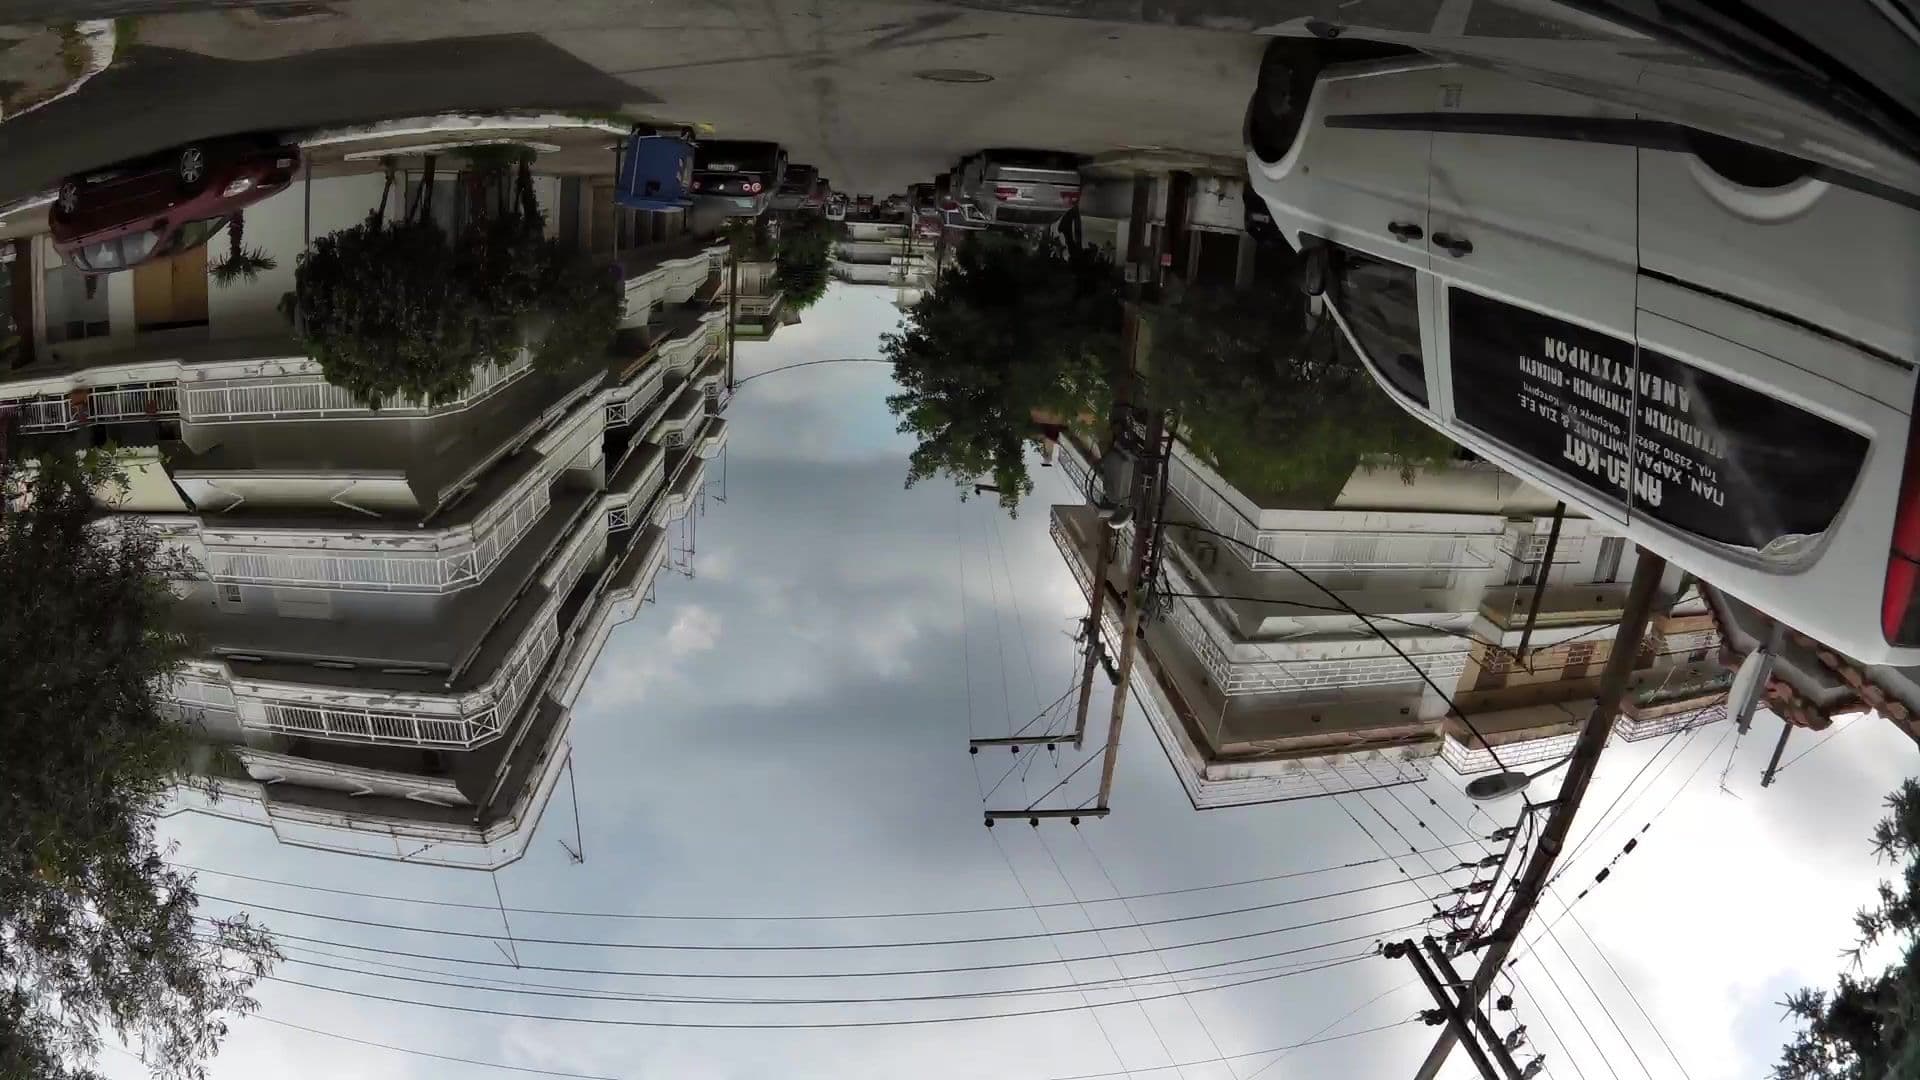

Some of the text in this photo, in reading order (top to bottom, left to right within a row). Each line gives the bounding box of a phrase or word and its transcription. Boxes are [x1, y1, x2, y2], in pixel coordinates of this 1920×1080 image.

[1545, 336, 1689, 412] ΑΝΕΛΚΥΣΤΗΡΩΝ
[1518, 392, 1536, 412] Ε.Ε.
[1539, 404, 1557, 423] ΣΙΑ
[1561, 413, 1570, 428] &
[1664, 448, 1693, 470] 23510
[1688, 475, 1724, 507] ΠΑΝ.
